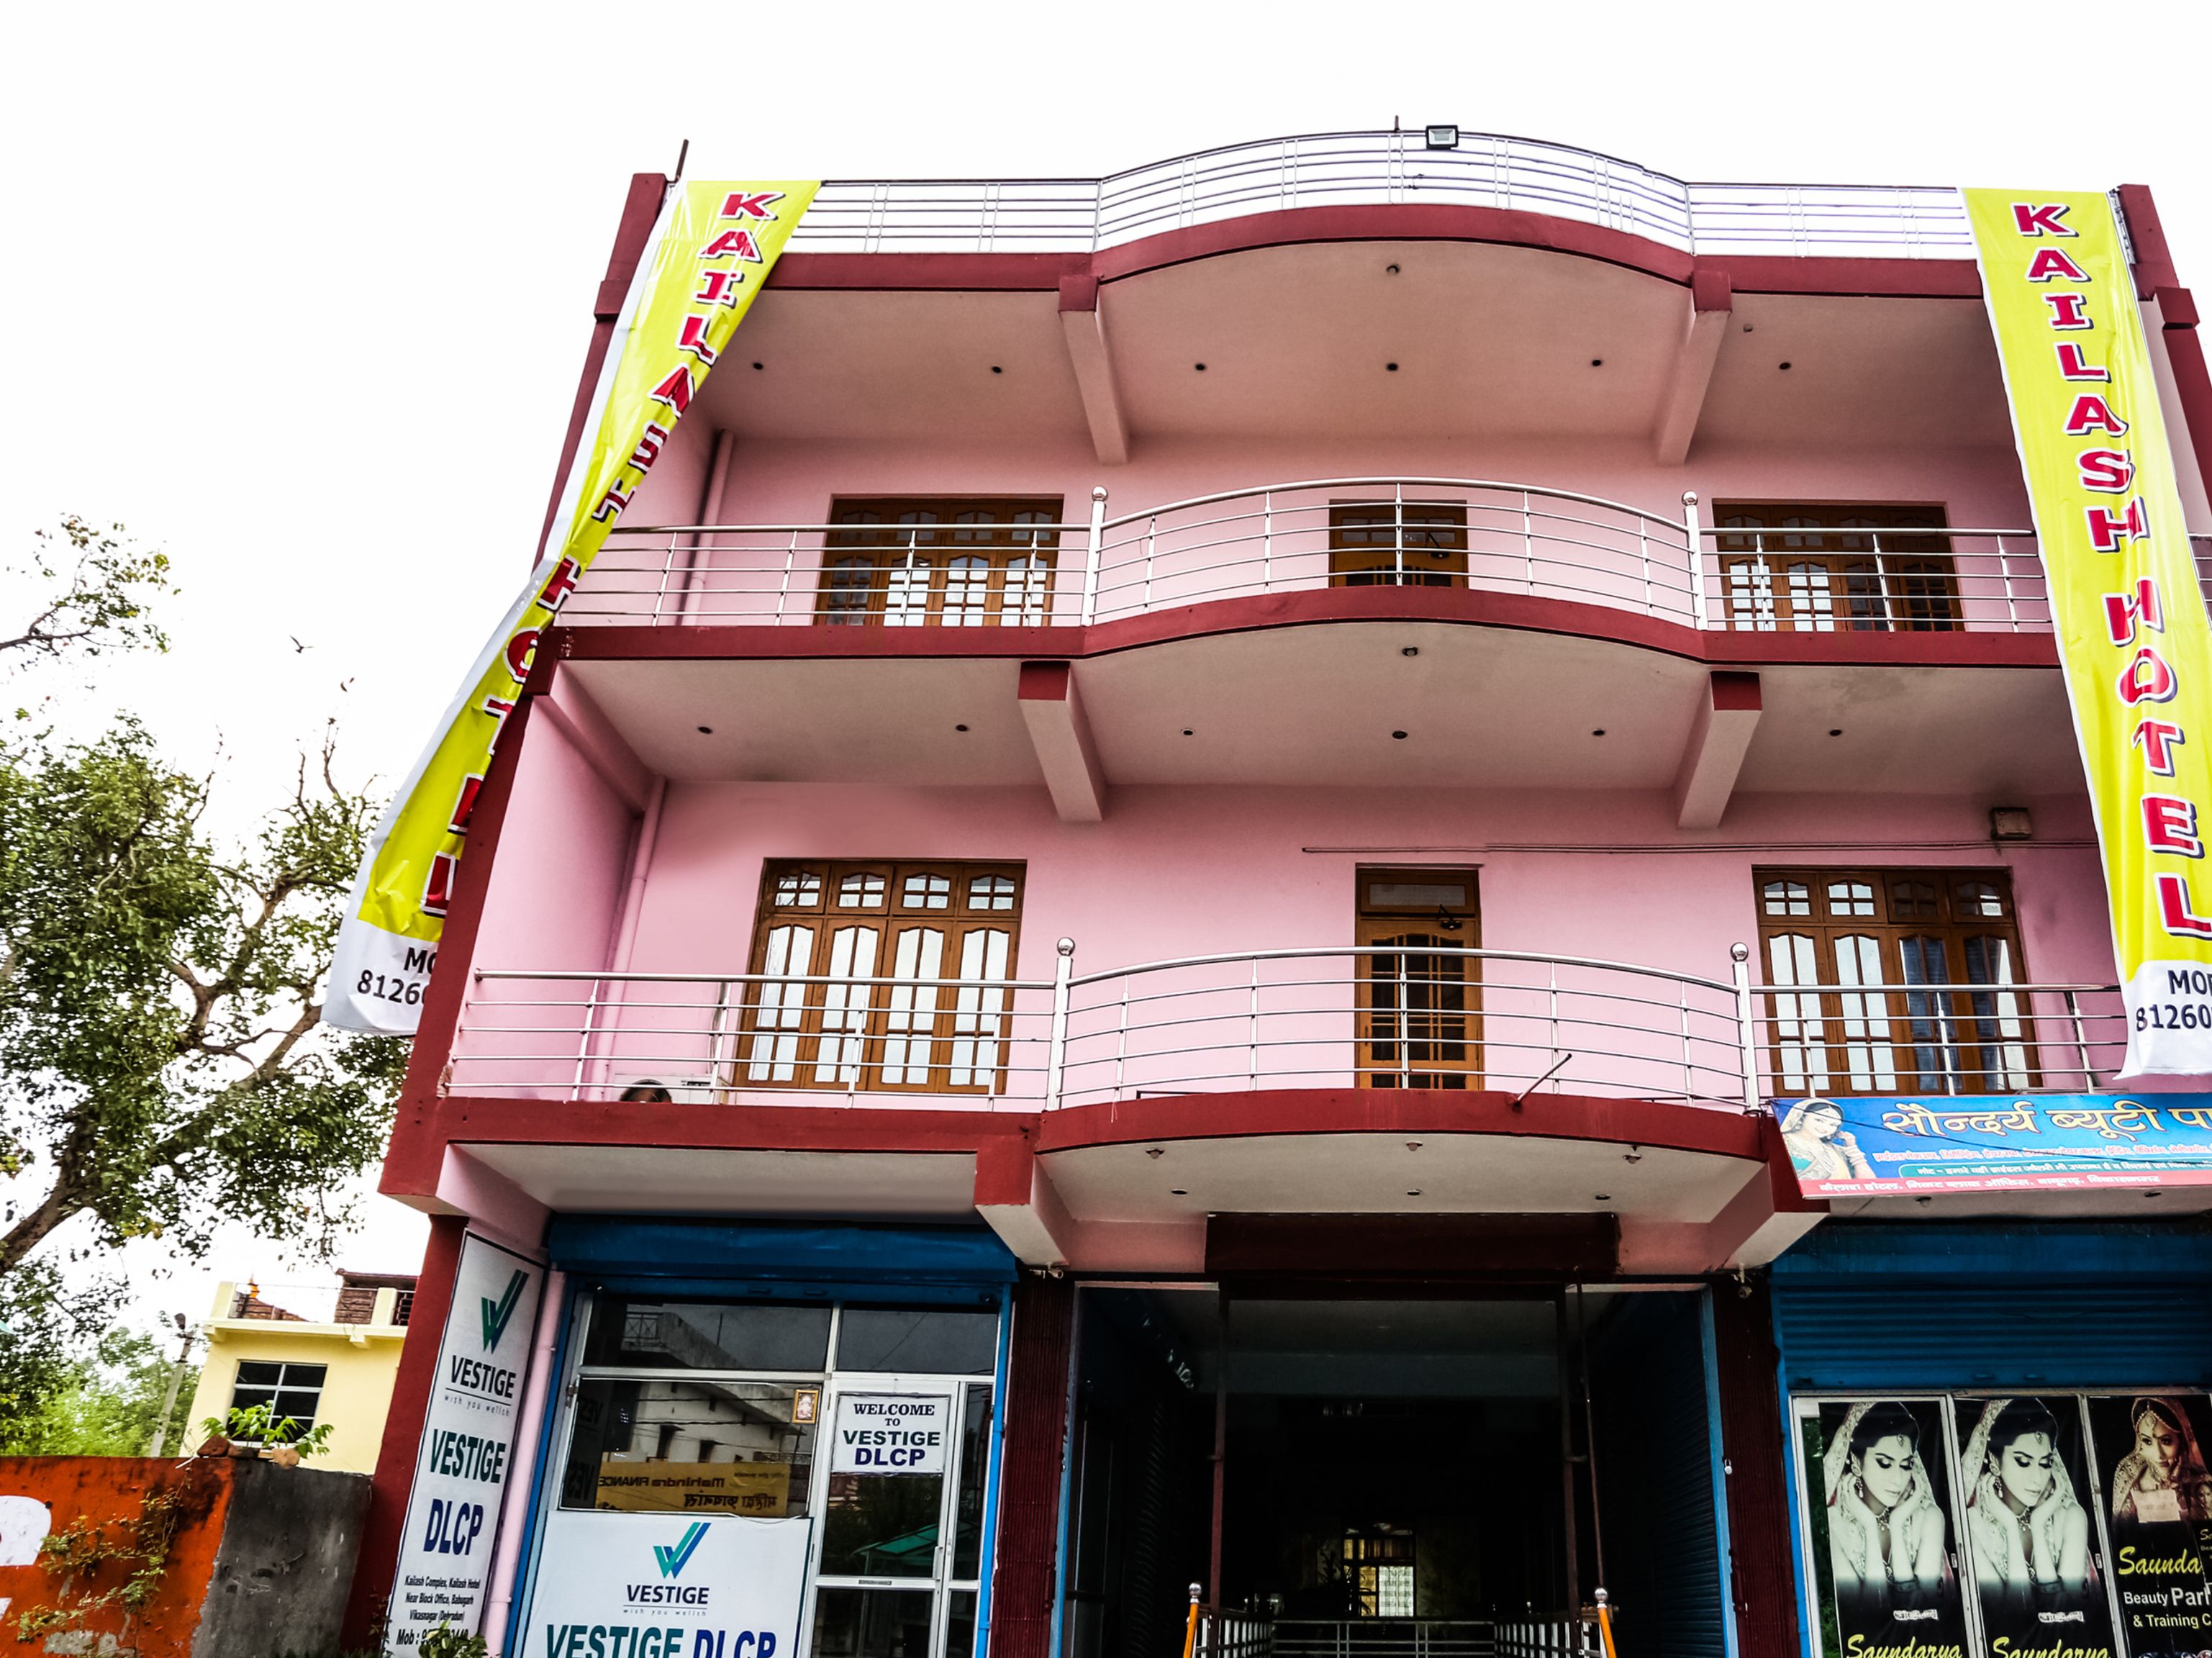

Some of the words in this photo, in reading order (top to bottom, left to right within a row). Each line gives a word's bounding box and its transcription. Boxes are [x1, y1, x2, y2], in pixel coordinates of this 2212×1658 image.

[2011, 203, 2150, 553] KAILASH
[2102, 576, 2212, 939] HOTEL
[2046, 1100, 2167, 1142] ब्यूटी
[450, 1355, 517, 1399] VESTIGE
[854, 1404, 935, 1416] WELCOME
[885, 1418, 900, 1426] TO
[843, 1430, 941, 1446] VESTIGE
[430, 1429, 507, 1484] VESTIGE
[854, 1448, 926, 1467] DLCP
[423, 1498, 484, 1556] DLCP
[627, 1584, 710, 1605] VESTIGE
[2123, 1591, 2168, 1607] Beauty
[2134, 1615, 2144, 1628] &
[2145, 1613, 2200, 1629] Training
[396, 1629, 414, 1645] Mob
[547, 1624, 684, 1658] VESTIGE
[1846, 1634, 1963, 1658] Saundarya
